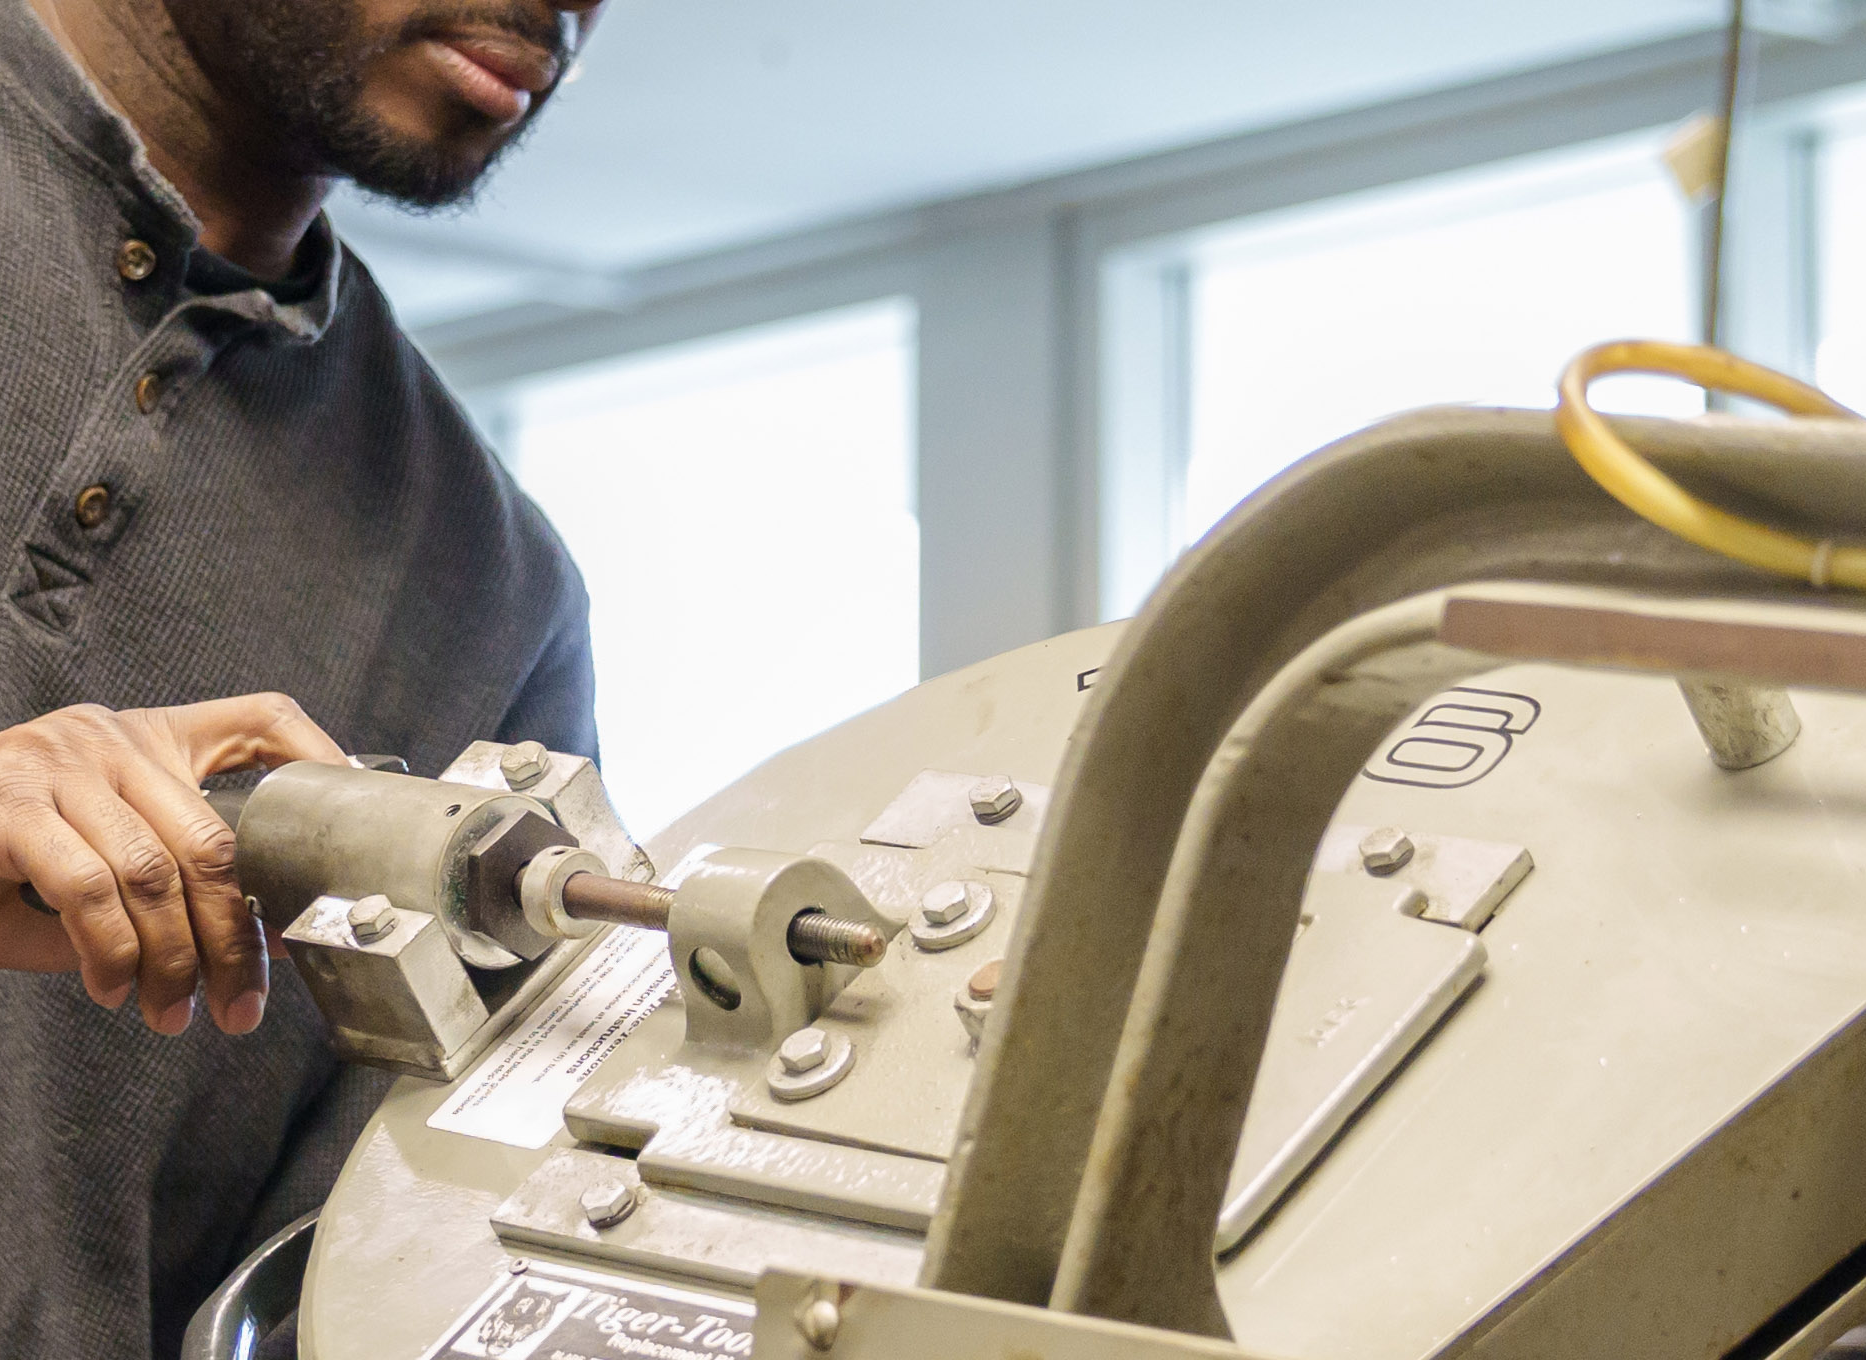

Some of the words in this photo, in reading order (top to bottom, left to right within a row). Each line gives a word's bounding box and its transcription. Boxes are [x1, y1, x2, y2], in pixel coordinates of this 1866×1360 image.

[629, 968, 676, 1007] ension
[534, 1004, 565, 1030] comes
[574, 1019, 599, 1039] least
[539, 1023, 559, 1038] and
[562, 1008, 638, 1075] Instructions
[501, 1045, 525, 1063] hard
[495, 1060, 522, 1082] blade
[571, 1290, 753, 1356] Tiger-Too
